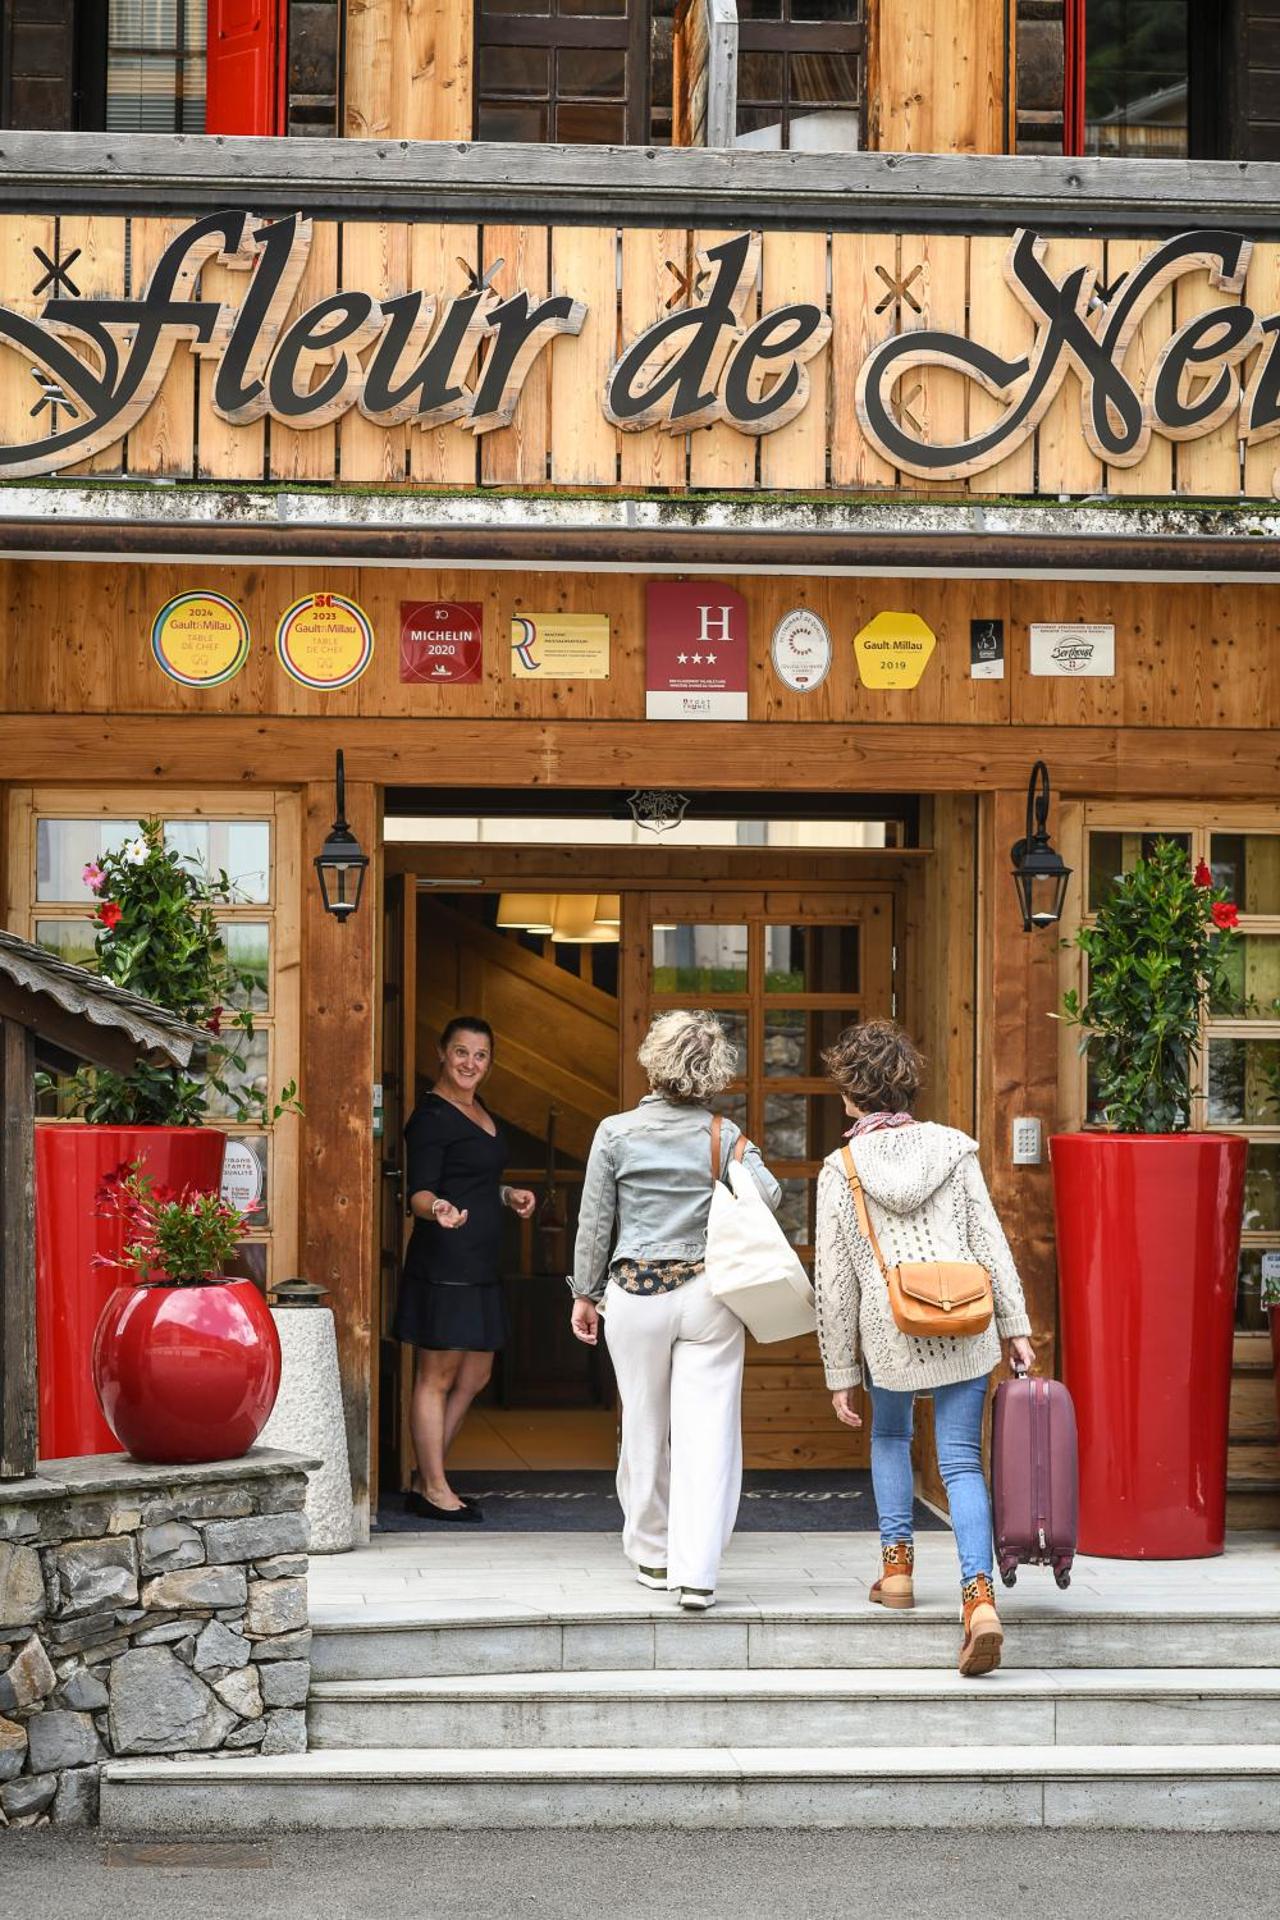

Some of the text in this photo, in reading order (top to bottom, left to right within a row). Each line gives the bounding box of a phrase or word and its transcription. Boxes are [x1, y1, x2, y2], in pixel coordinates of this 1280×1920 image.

[609, 231, 824, 422] de
[189, 608, 214, 617] 2024
[312, 612, 337, 620] 2023
[696, 605, 735, 641] H
[410, 630, 473, 642] MICHELIN
[427, 644, 456, 655] 2020
[880, 661, 906, 670] 2019
